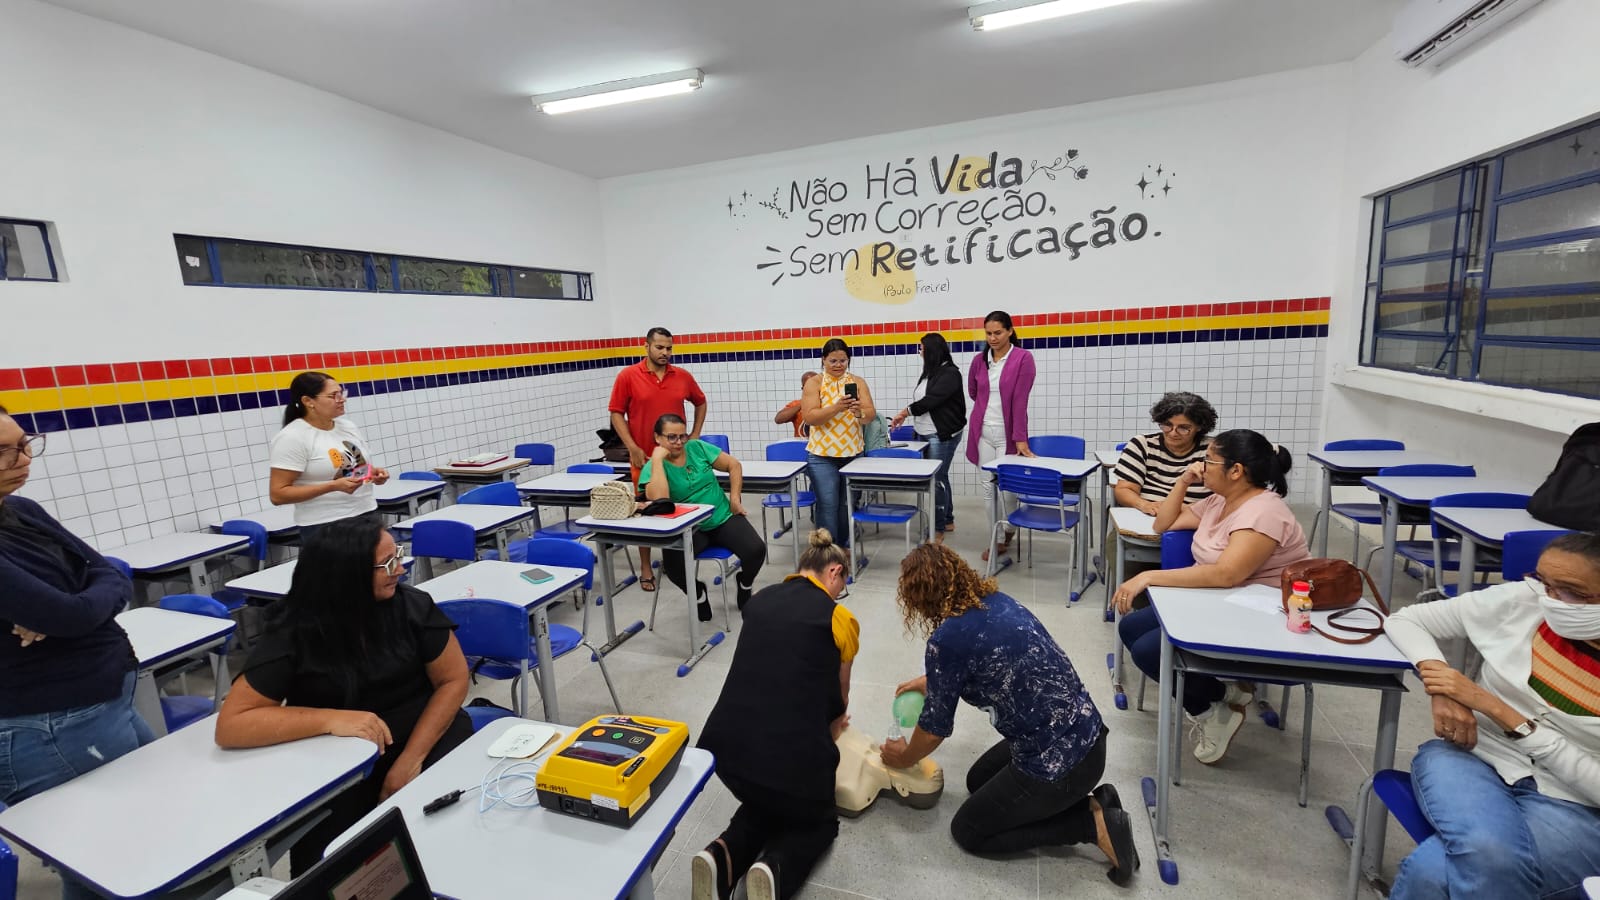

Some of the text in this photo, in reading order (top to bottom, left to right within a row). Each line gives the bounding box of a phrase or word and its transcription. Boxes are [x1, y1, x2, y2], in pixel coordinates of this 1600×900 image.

[790, 151, 1023, 212] Não Há Vida
[806, 189, 1056, 238] Sem Correção,
[790, 206, 1162, 277] Sem Retificação.
[883, 277, 950, 297] (Paulo Freire)
